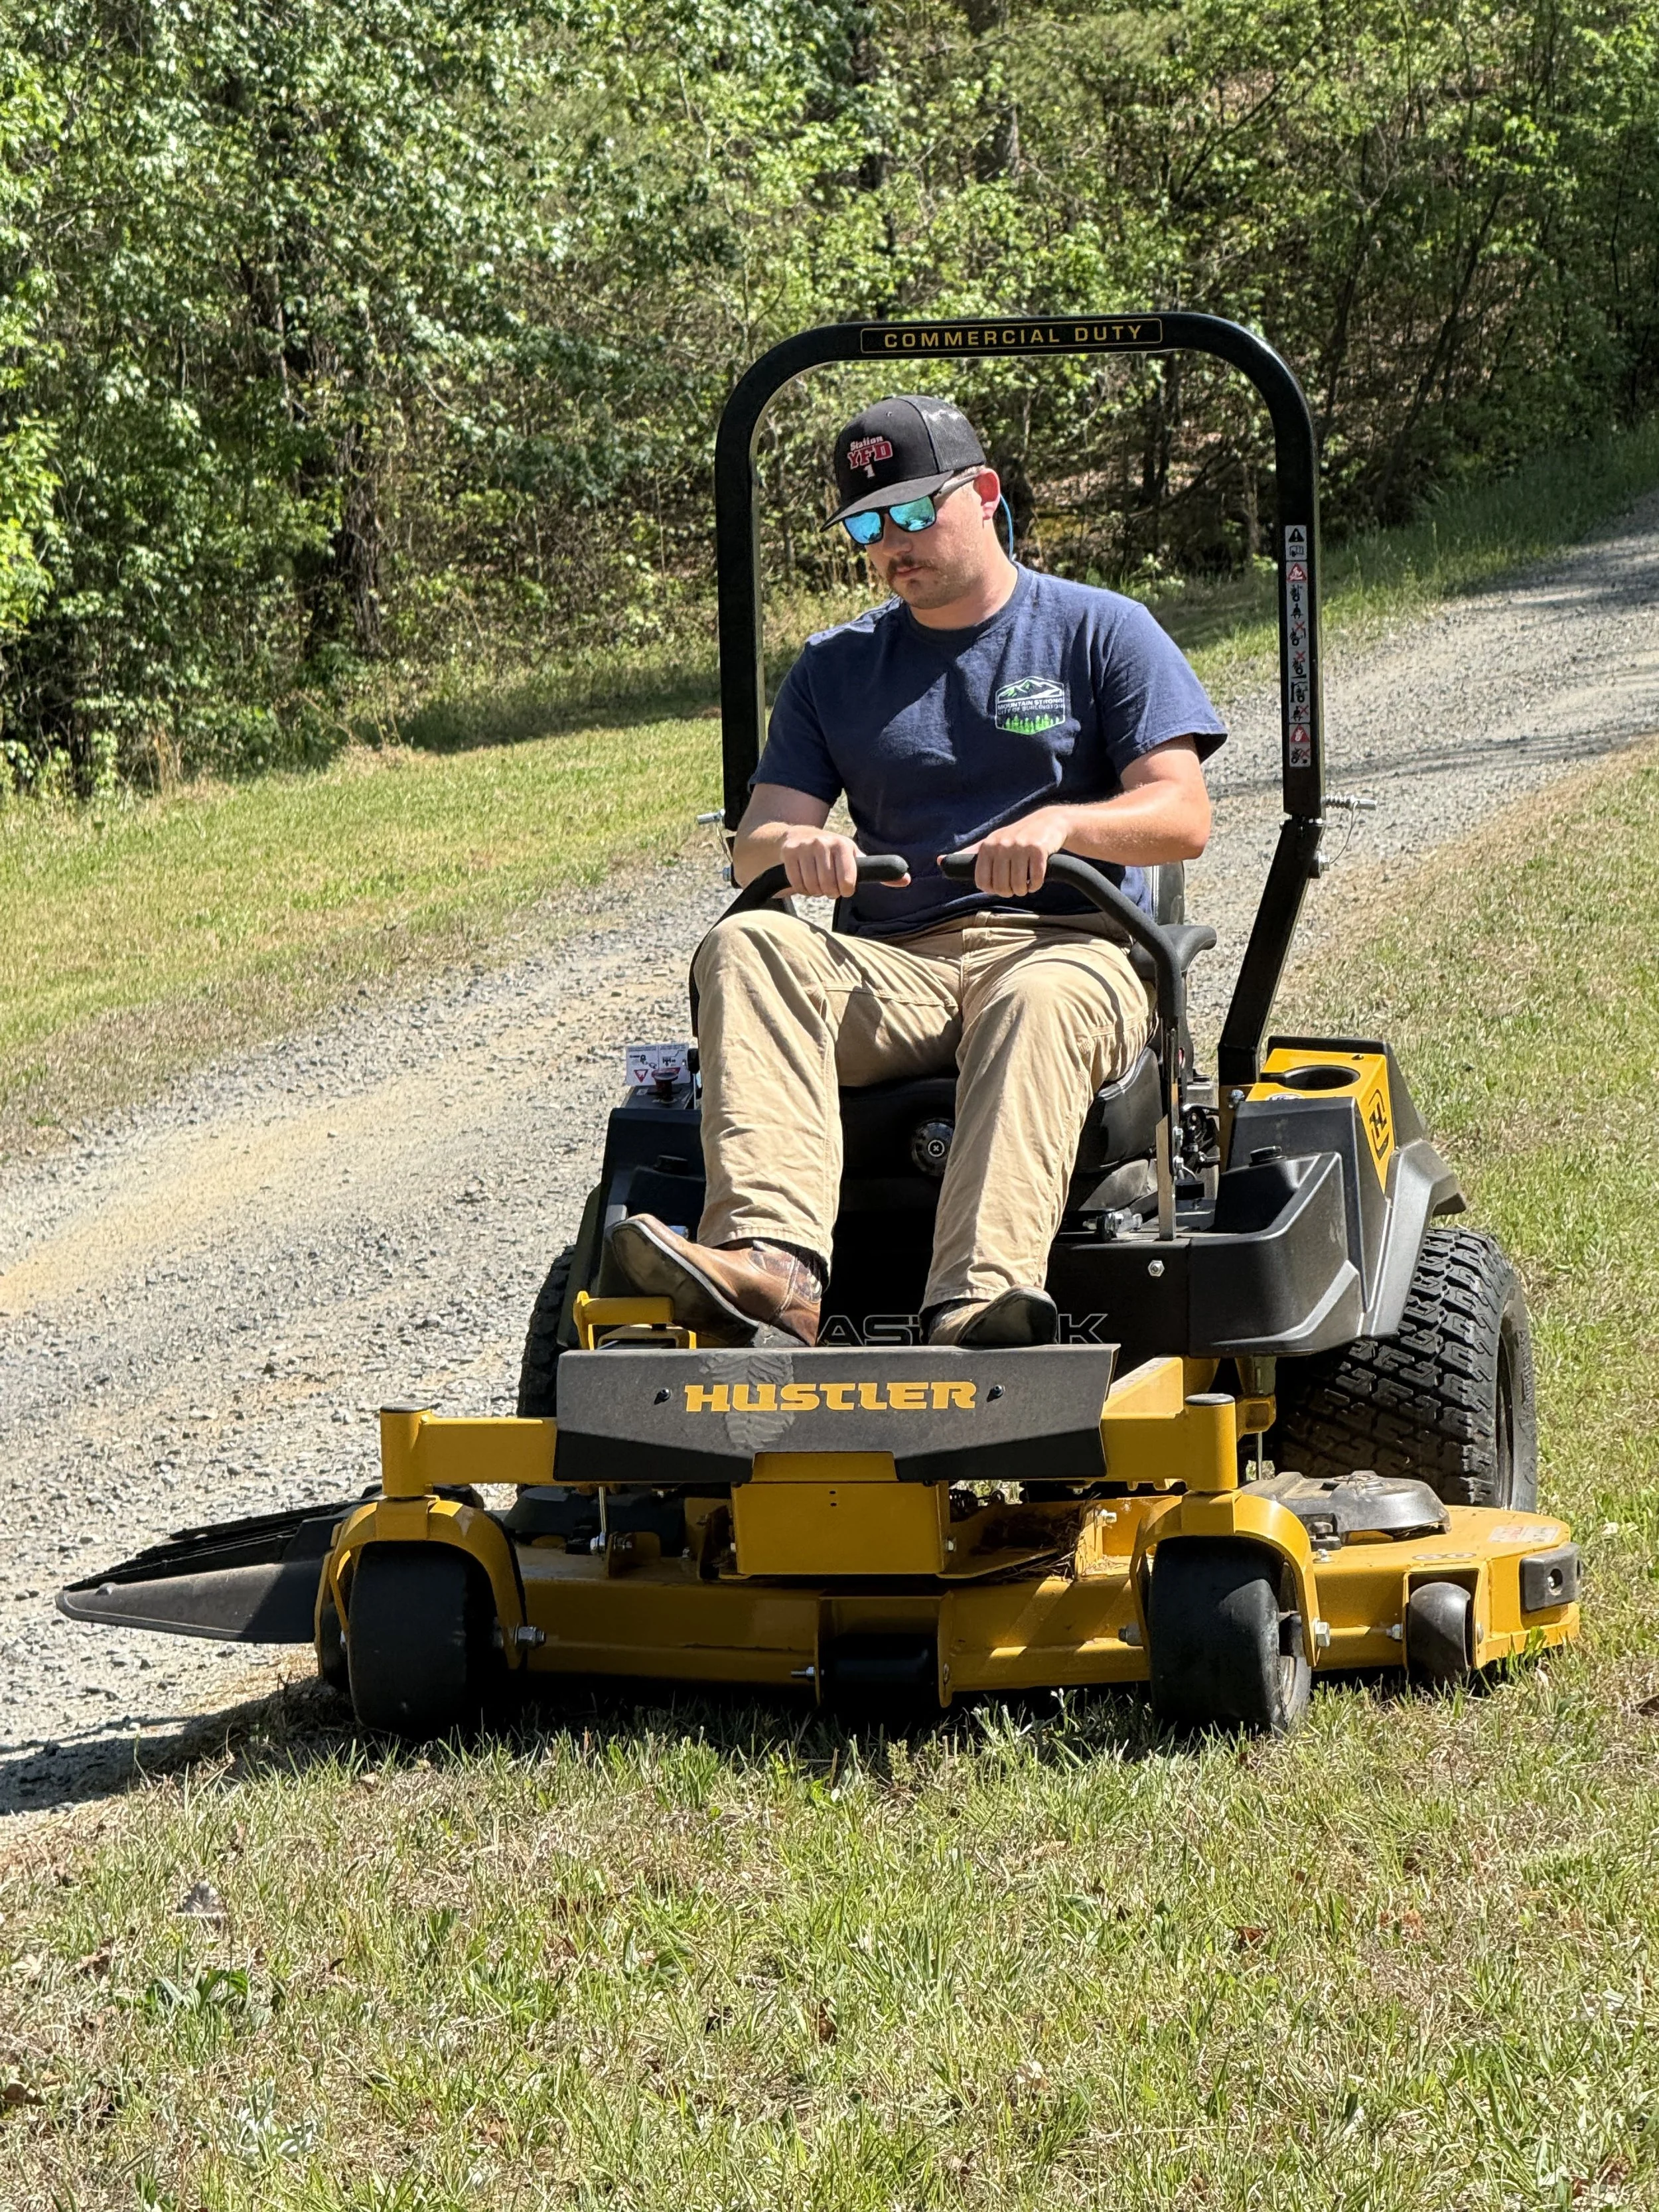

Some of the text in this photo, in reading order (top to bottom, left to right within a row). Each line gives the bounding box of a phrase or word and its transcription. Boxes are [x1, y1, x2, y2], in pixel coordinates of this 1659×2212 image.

[885, 325, 1141, 348] COMMERCIAL DUTY
[850, 435, 883, 451] Station
[847, 441, 893, 469] YFD
[863, 464, 875, 479] 1
[997, 701, 1033, 710] MOUNTAIN
[685, 1382, 976, 1412] HUSTLER
